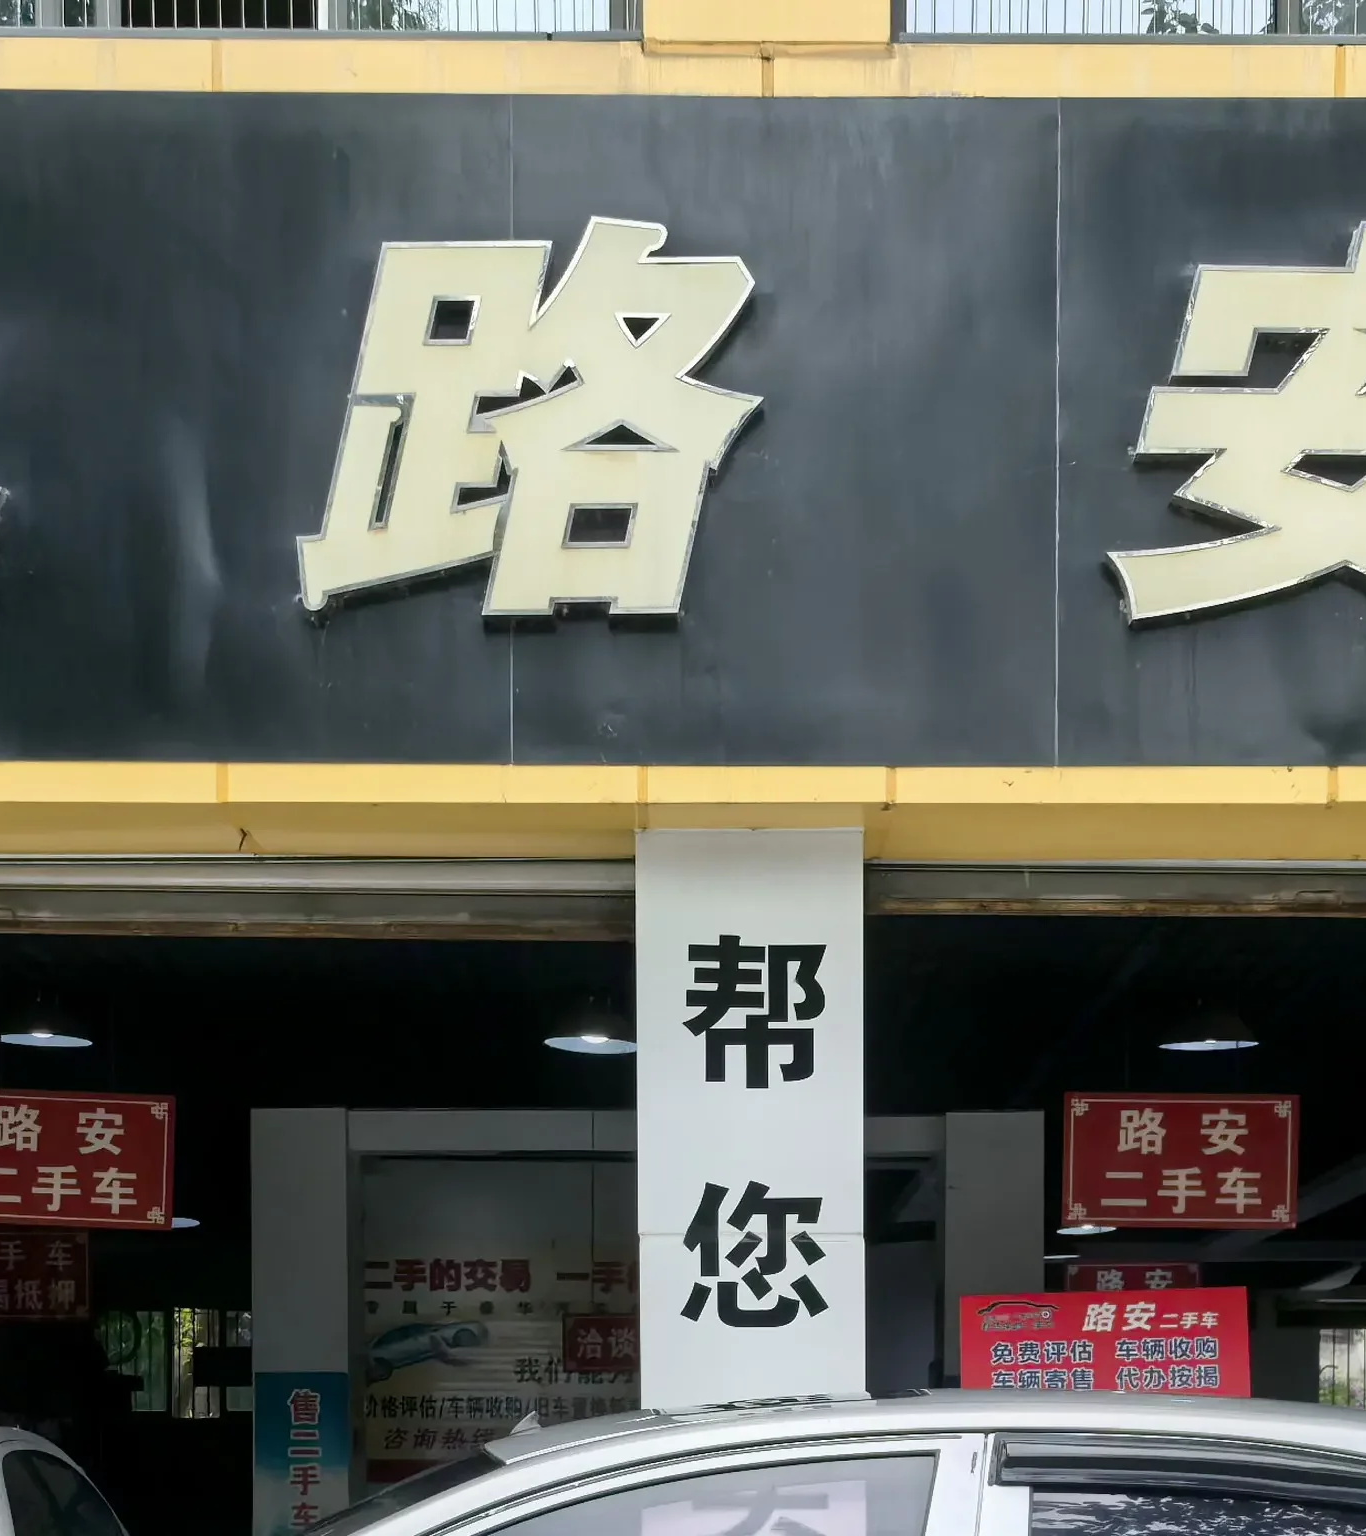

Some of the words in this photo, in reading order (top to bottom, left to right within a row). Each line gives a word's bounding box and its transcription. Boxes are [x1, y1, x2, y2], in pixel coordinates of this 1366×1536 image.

[1117, 1107, 1249, 1156] 路安
[1100, 1167, 1262, 1214] 二手车
[364, 1258, 532, 1292] 二手的交易
[1095, 1269, 1174, 1290] 路安
[990, 1340, 1094, 1364] 免费评估
[1115, 1336, 1219, 1361] 车辆收购
[992, 1367, 1094, 1390] 车辆寄售
[1116, 1364, 1220, 1390] 代办按揭
